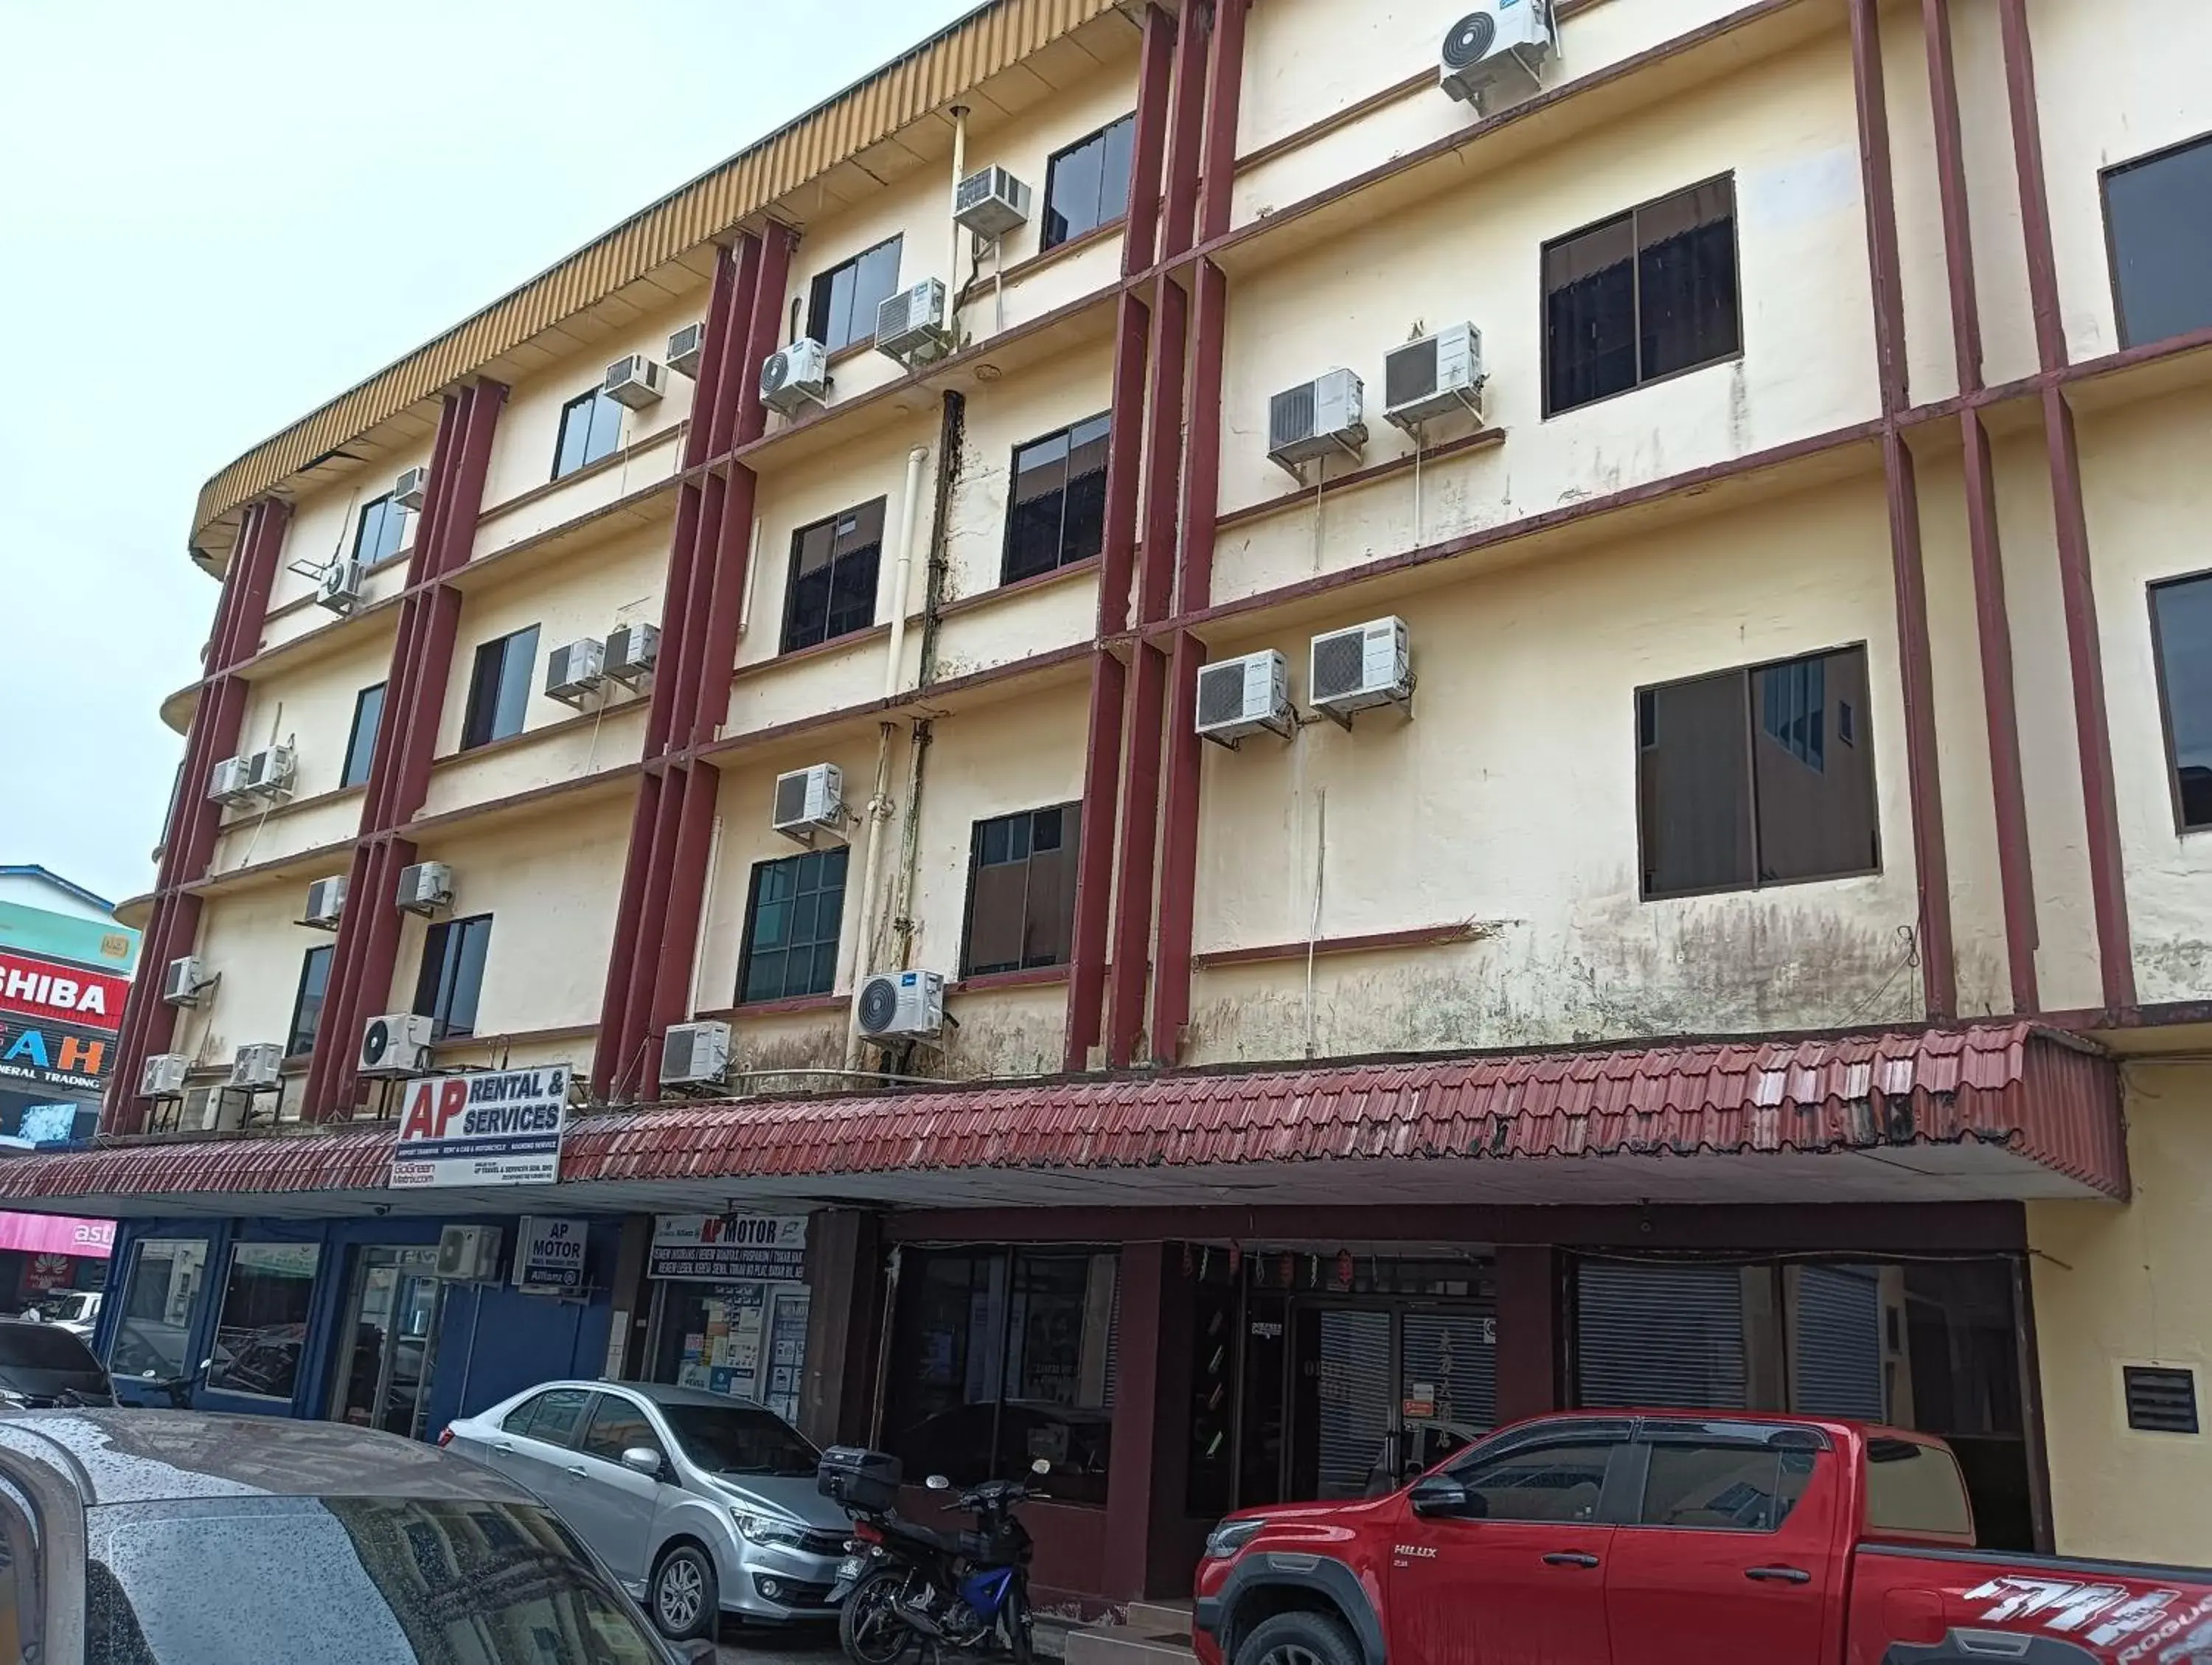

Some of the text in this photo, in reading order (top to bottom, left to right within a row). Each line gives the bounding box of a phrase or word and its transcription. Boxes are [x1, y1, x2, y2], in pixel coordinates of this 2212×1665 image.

[0, 967, 105, 1015] HIBA
[0, 1025, 105, 1075] AH
[44, 1071, 100, 1088] TRADING
[402, 1069, 564, 1139] AP RENTAL &
[463, 1103, 559, 1136] SERVICES
[550, 1223, 568, 1239] AP
[723, 1220, 777, 1244] MOTOR
[533, 1240, 581, 1258] MOTOR
[1394, 1545, 1437, 1558] HILUX
